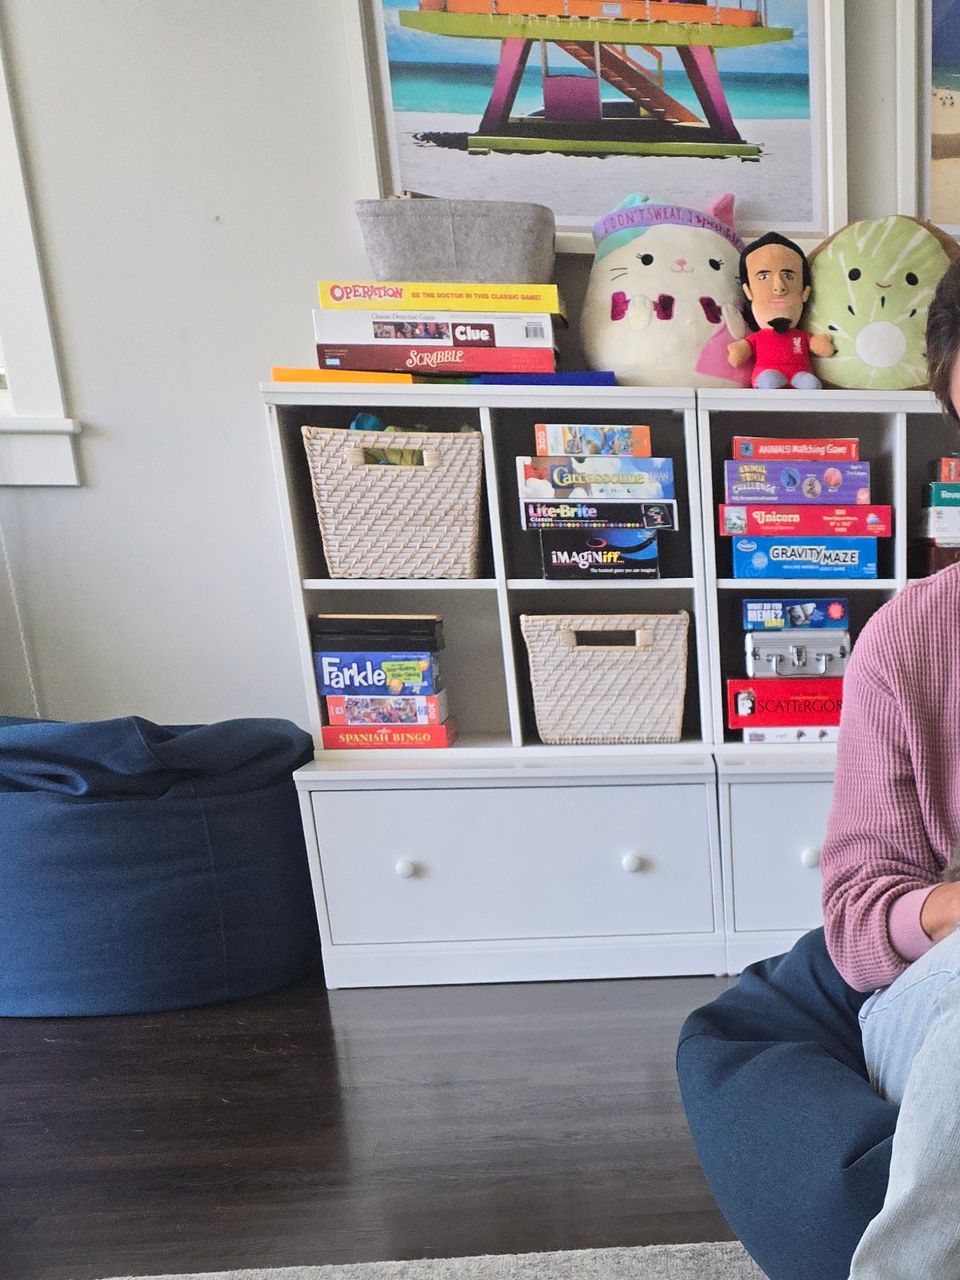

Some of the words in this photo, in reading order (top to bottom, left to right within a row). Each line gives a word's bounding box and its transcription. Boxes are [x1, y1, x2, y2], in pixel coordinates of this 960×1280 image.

[610, 209, 645, 229] DON'T
[330, 284, 403, 301] OPERATION
[454, 325, 490, 341] Clue
[406, 349, 464, 367] SCRABBLE
[771, 547, 822, 561] GRAVITY
[823, 551, 858, 563] MAZE
[321, 656, 386, 689] Farkle
[338, 732, 389, 743] SPANISH
[393, 732, 431, 742] BINGO
